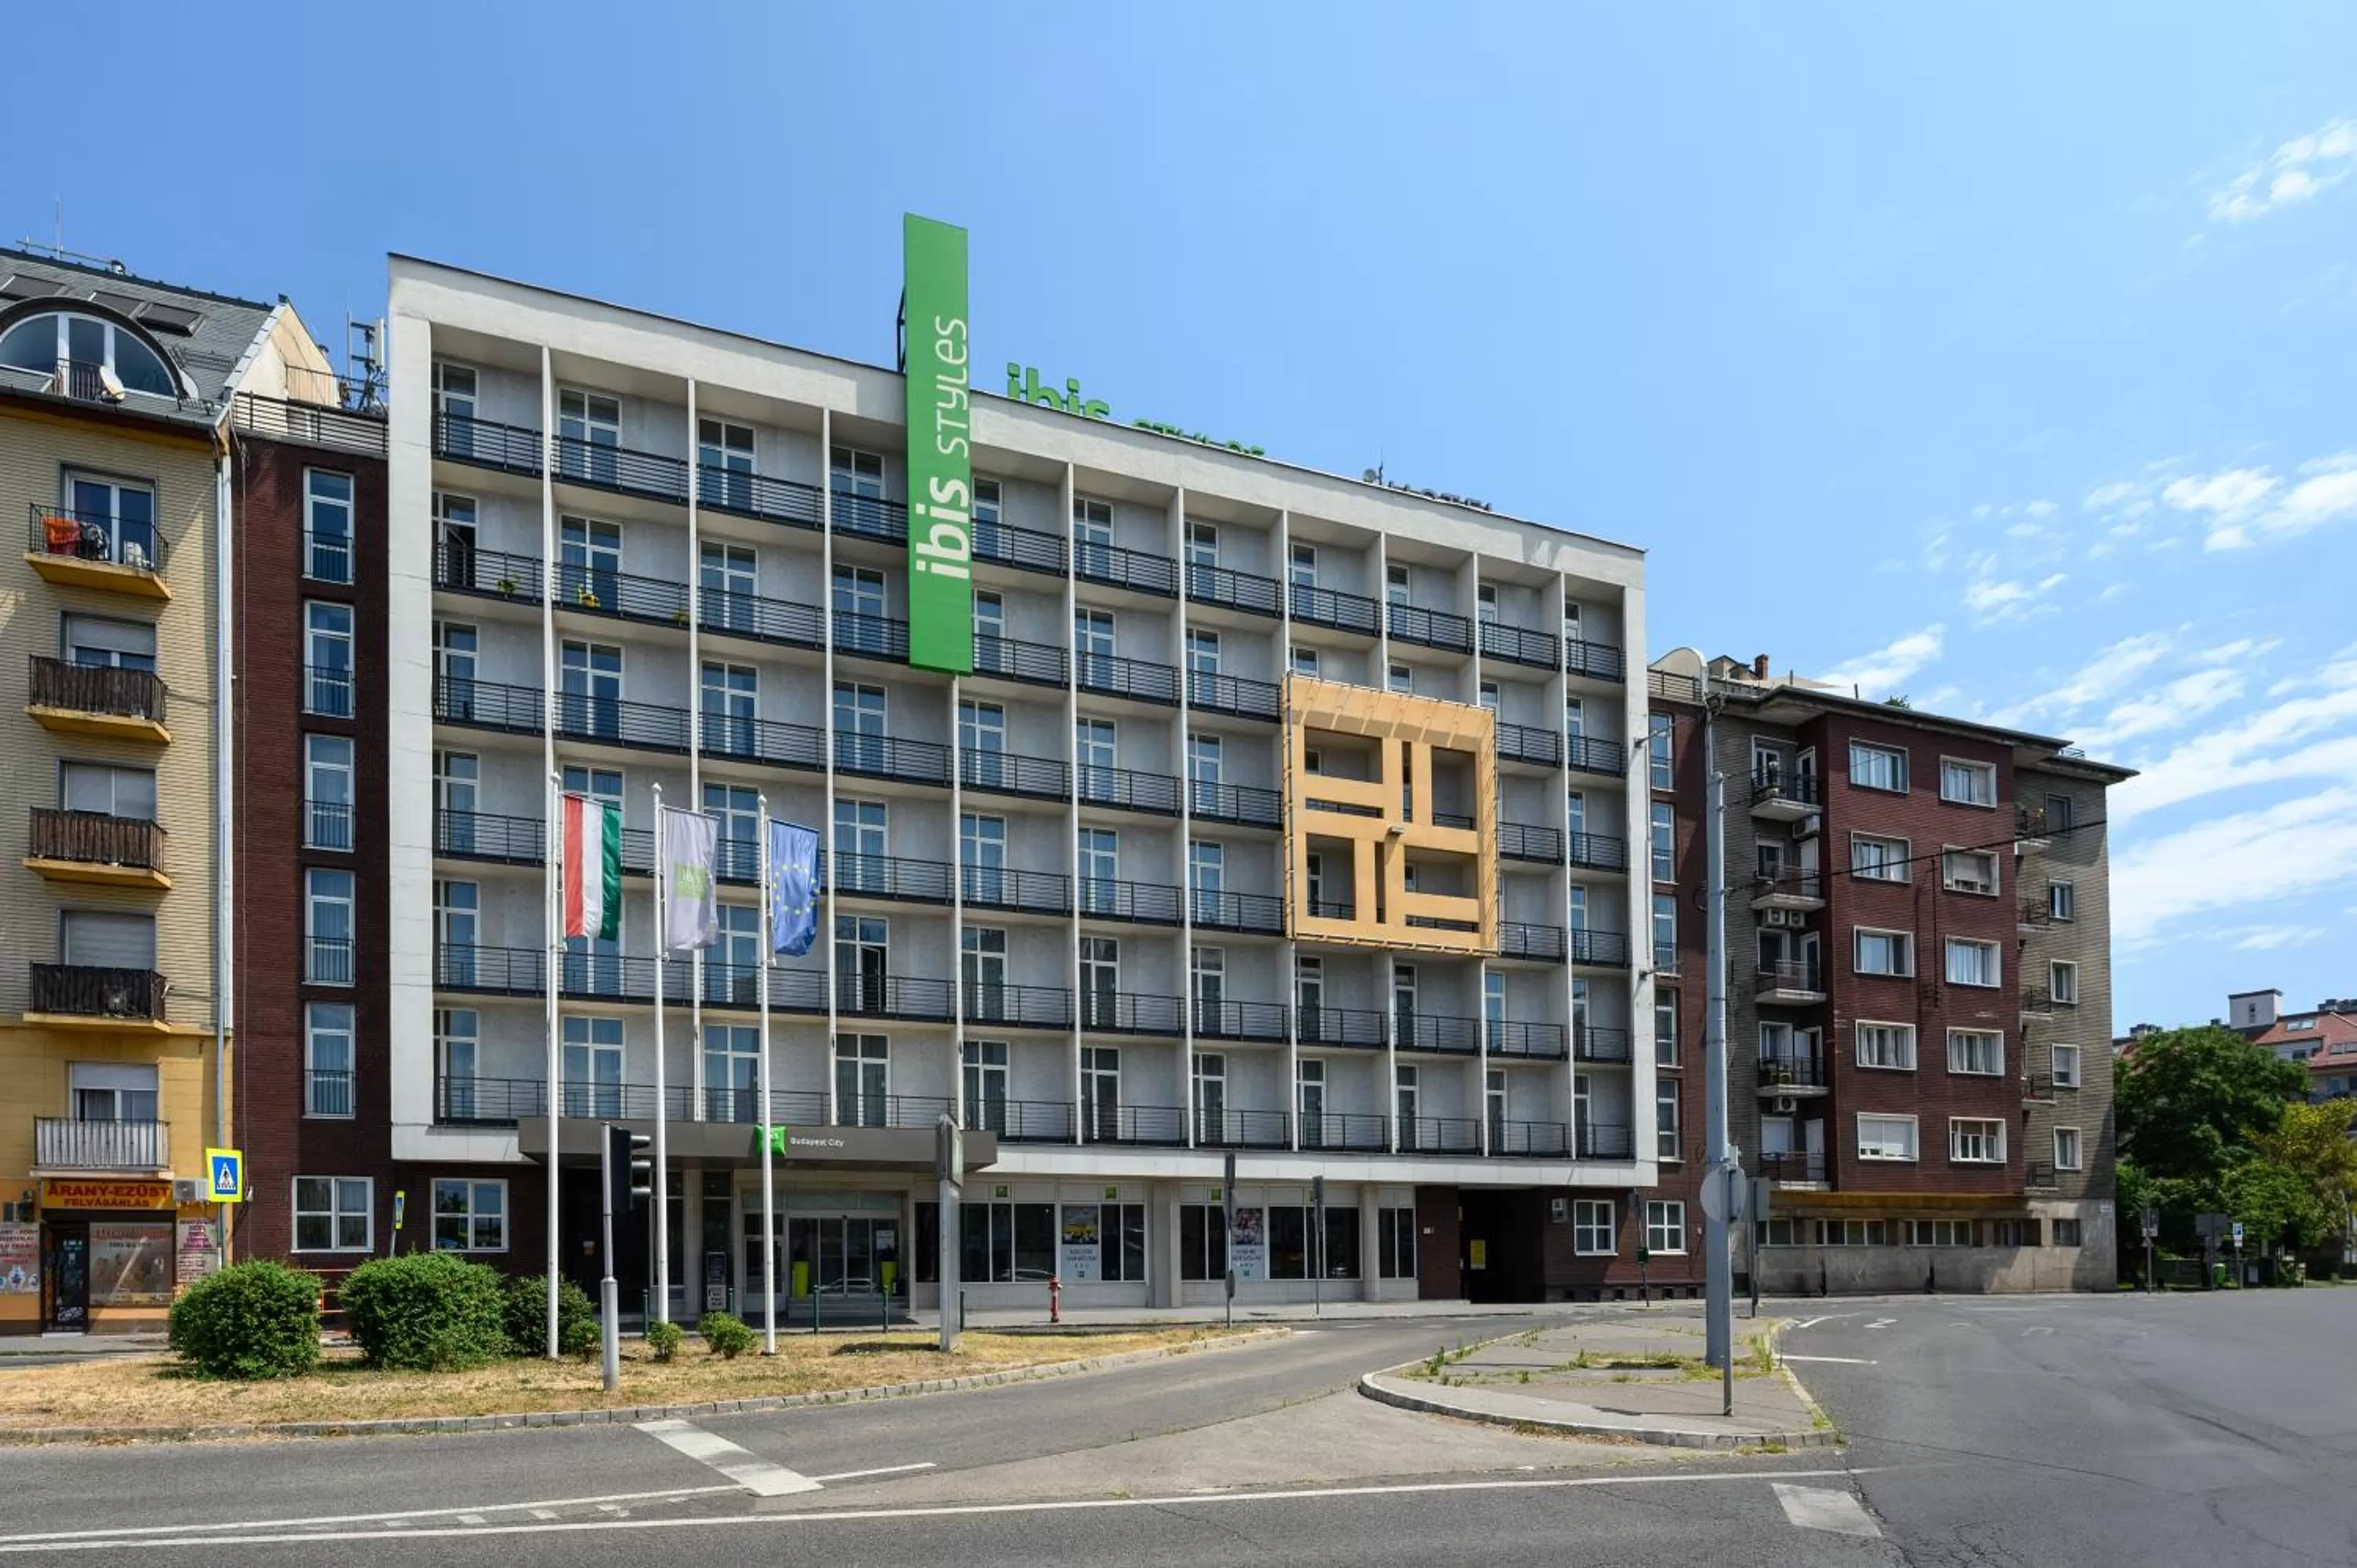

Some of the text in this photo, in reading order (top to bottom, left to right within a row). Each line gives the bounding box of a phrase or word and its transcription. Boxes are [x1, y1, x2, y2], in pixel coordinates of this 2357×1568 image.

[915, 477, 970, 578] ibis
[790, 1137, 844, 1147] Budapest City
